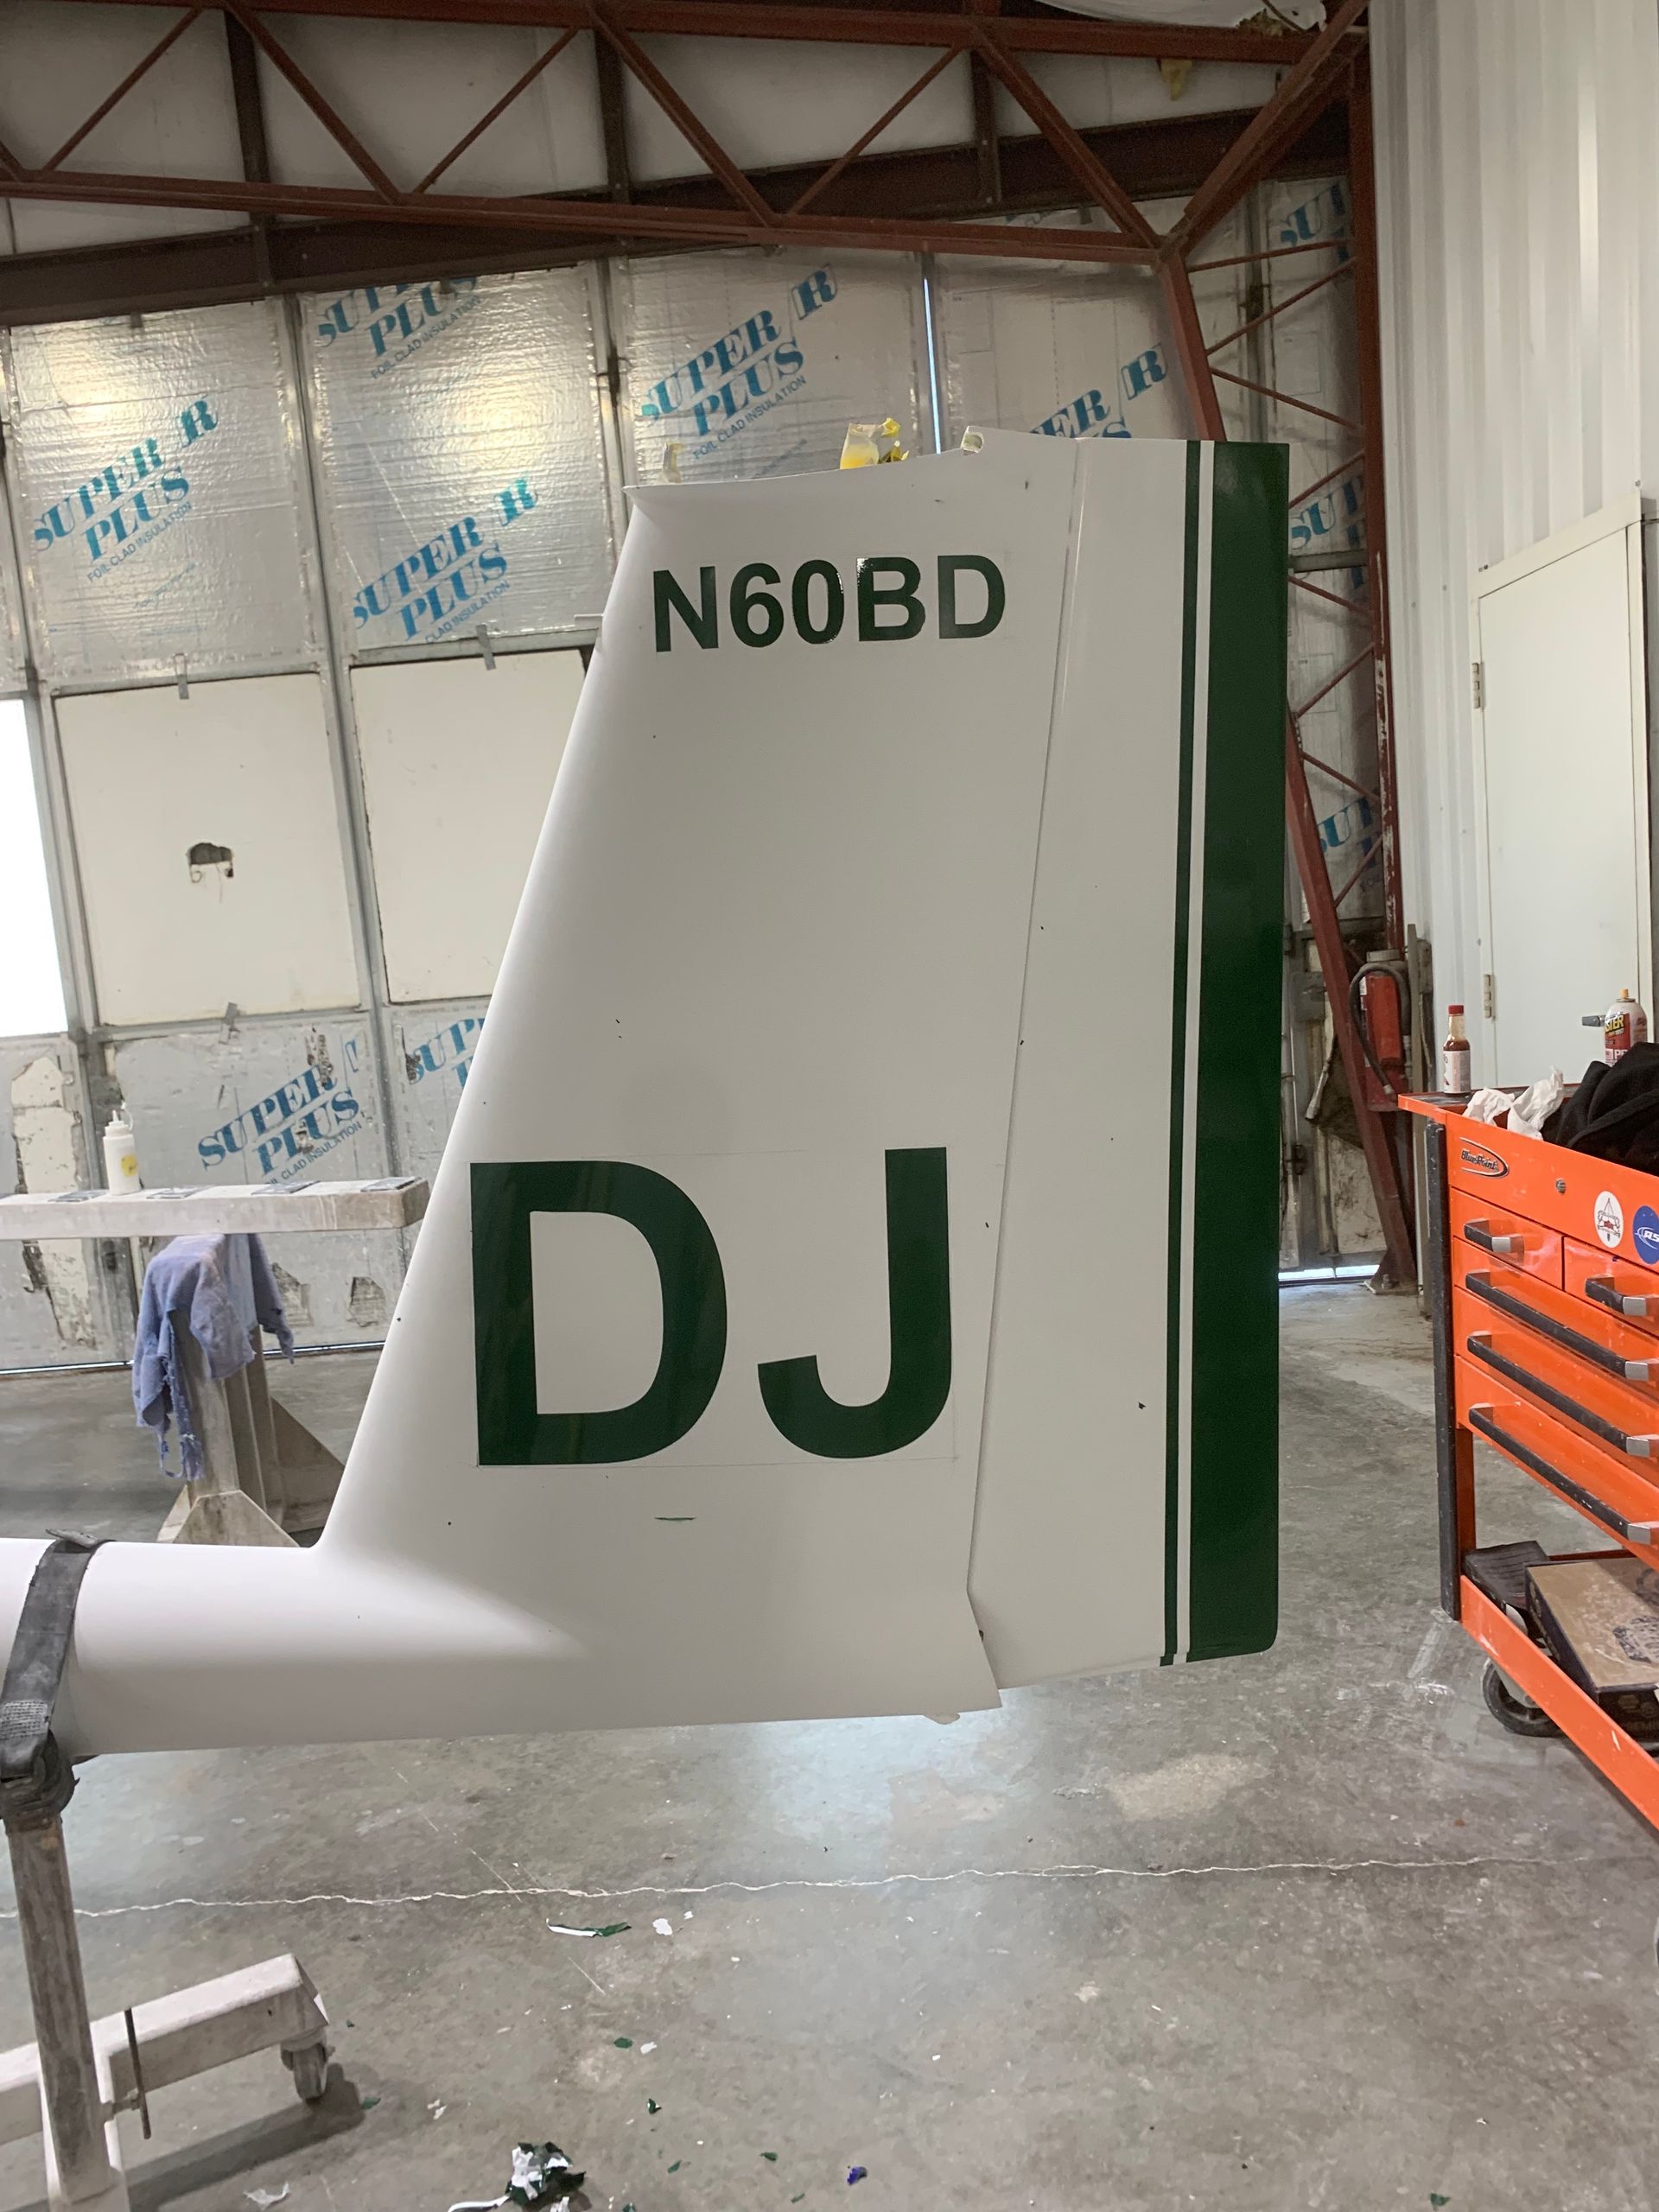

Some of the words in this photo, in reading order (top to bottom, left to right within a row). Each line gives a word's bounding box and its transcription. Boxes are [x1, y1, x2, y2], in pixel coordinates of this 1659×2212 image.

[394, 340, 422, 362] CLAD
[639, 310, 781, 428] SUPER
[791, 263, 836, 320] R
[692, 337, 804, 435] PLUS
[1121, 342, 1166, 400] R
[693, 442, 717, 459] FOIL
[718, 420, 745, 443] CLAD
[746, 376, 806, 423] INSULATION
[35, 438, 166, 551] SUPER
[178, 395, 218, 448] R
[82, 467, 189, 563] PLUS
[87, 564, 111, 582] FOIL
[111, 543, 136, 565] CLAD
[137, 502, 192, 547] INSULATION
[353, 517, 484, 629] SUPER
[494, 473, 538, 526] R
[397, 543, 507, 641] PLUS
[425, 622, 452, 642] CLAD
[452, 580, 510, 626] INSULATION
[653, 555, 1005, 652] N60BD
[198, 1064, 337, 1172] SUPER
[253, 1086, 359, 1178] PLUS
[281, 1159, 307, 1179] CLAD
[308, 1122, 362, 1162] INSULATION
[470, 1147, 951, 1465] DJ
